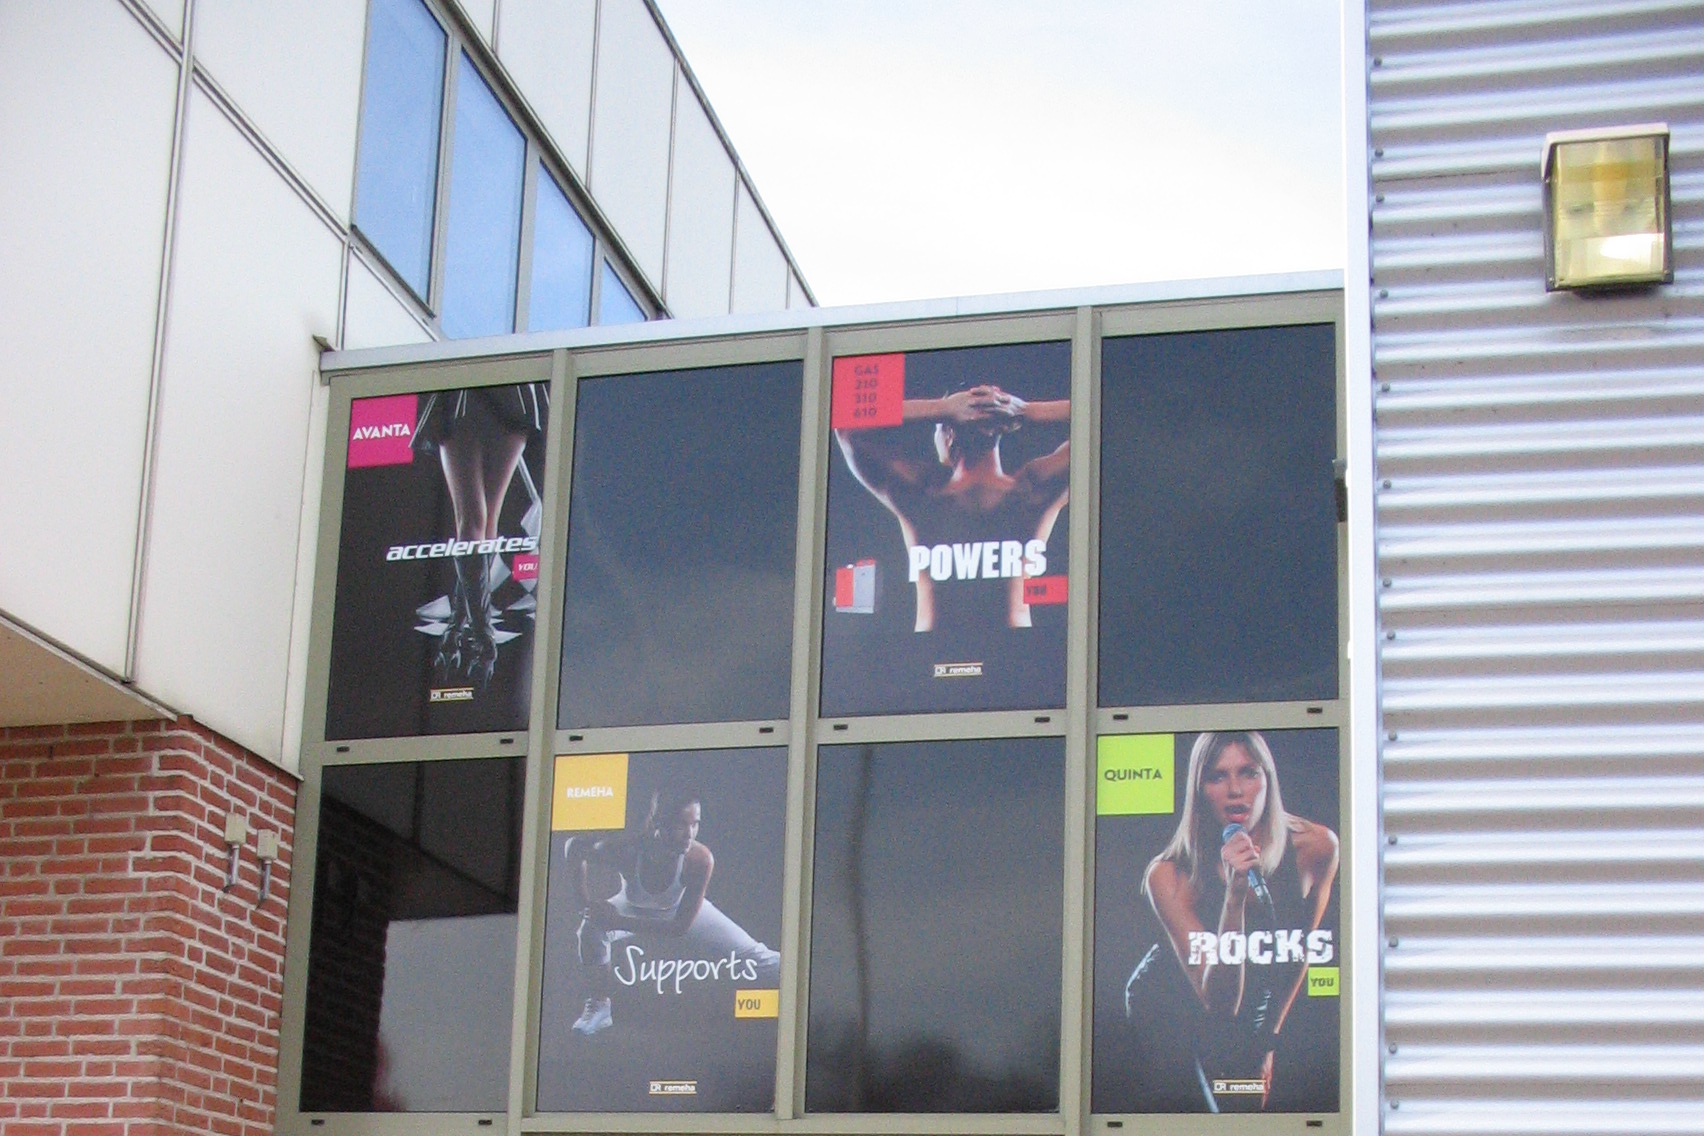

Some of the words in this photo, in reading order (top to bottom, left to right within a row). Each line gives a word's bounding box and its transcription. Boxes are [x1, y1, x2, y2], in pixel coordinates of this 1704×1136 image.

[854, 365, 879, 376] GAS
[854, 379, 878, 390] 210
[353, 423, 411, 441] AVANTA
[386, 535, 538, 562] accelerates
[518, 561, 538, 573] YOU
[908, 539, 1047, 583] POWERS
[1104, 767, 1163, 783] QUINTA
[566, 786, 614, 799] REMEHA
[1188, 928, 1334, 966] ROCKS
[614, 944, 759, 995] Supports
[1310, 976, 1335, 989] YOU
[737, 998, 761, 1011] YOU
